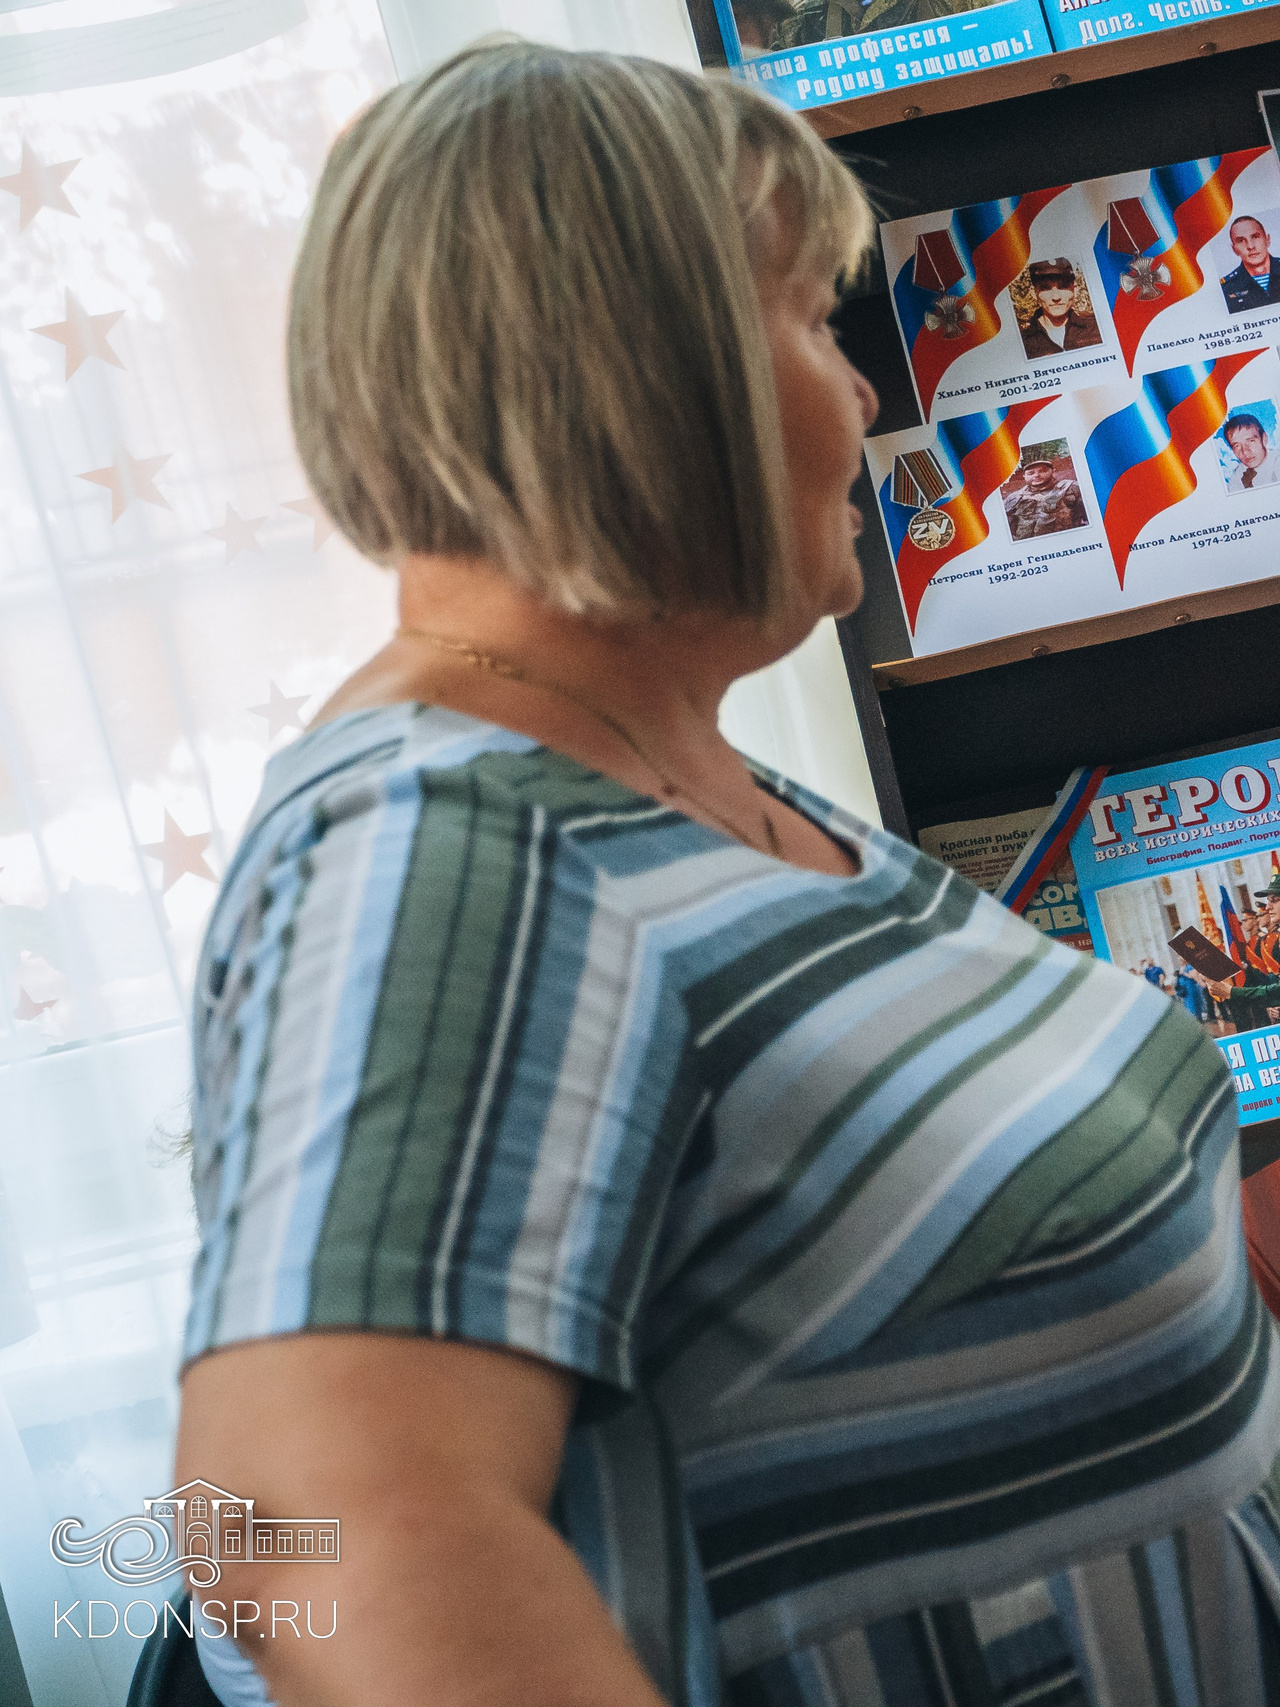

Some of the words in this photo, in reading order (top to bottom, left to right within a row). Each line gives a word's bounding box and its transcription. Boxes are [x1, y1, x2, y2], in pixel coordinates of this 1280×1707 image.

[1078, 12, 1144, 45] Долг.
[1148, 0, 1231, 23] Честь.
[742, 54, 807, 84] Наша
[818, 25, 951, 69] профессия
[797, 67, 885, 100] Родину
[897, 29, 1034, 81] защищать!
[1147, 337, 1196, 353] Павелко
[1197, 322, 1241, 343] Андрей
[1203, 331, 1263, 352] 1988-2022
[936, 386, 982, 401] Хилько
[983, 371, 1031, 390] Никита
[1033, 353, 1118, 380] Вячеславович
[999, 377, 1062, 398] 2001-2022
[1128, 536, 1166, 552] Мигов
[1168, 523, 1231, 545] Александр
[1191, 528, 1252, 551] 1974-2023
[928, 568, 983, 587] Петросян
[987, 560, 1023, 574] Карен
[1027, 542, 1103, 564] Геннадьевич
[988, 565, 1049, 585] 1992-2023
[939, 834, 992, 851] Красная
[995, 829, 1029, 844] рыба
[942, 847, 988, 862] плывет
[991, 845, 1000, 854] в
[1001, 841, 1027, 855] рук
[1094, 841, 1141, 863] ВСЕХ
[1146, 847, 1206, 866] Биография.
[1207, 836, 1248, 853] Подвиг.
[1220, 1042, 1246, 1071] Я
